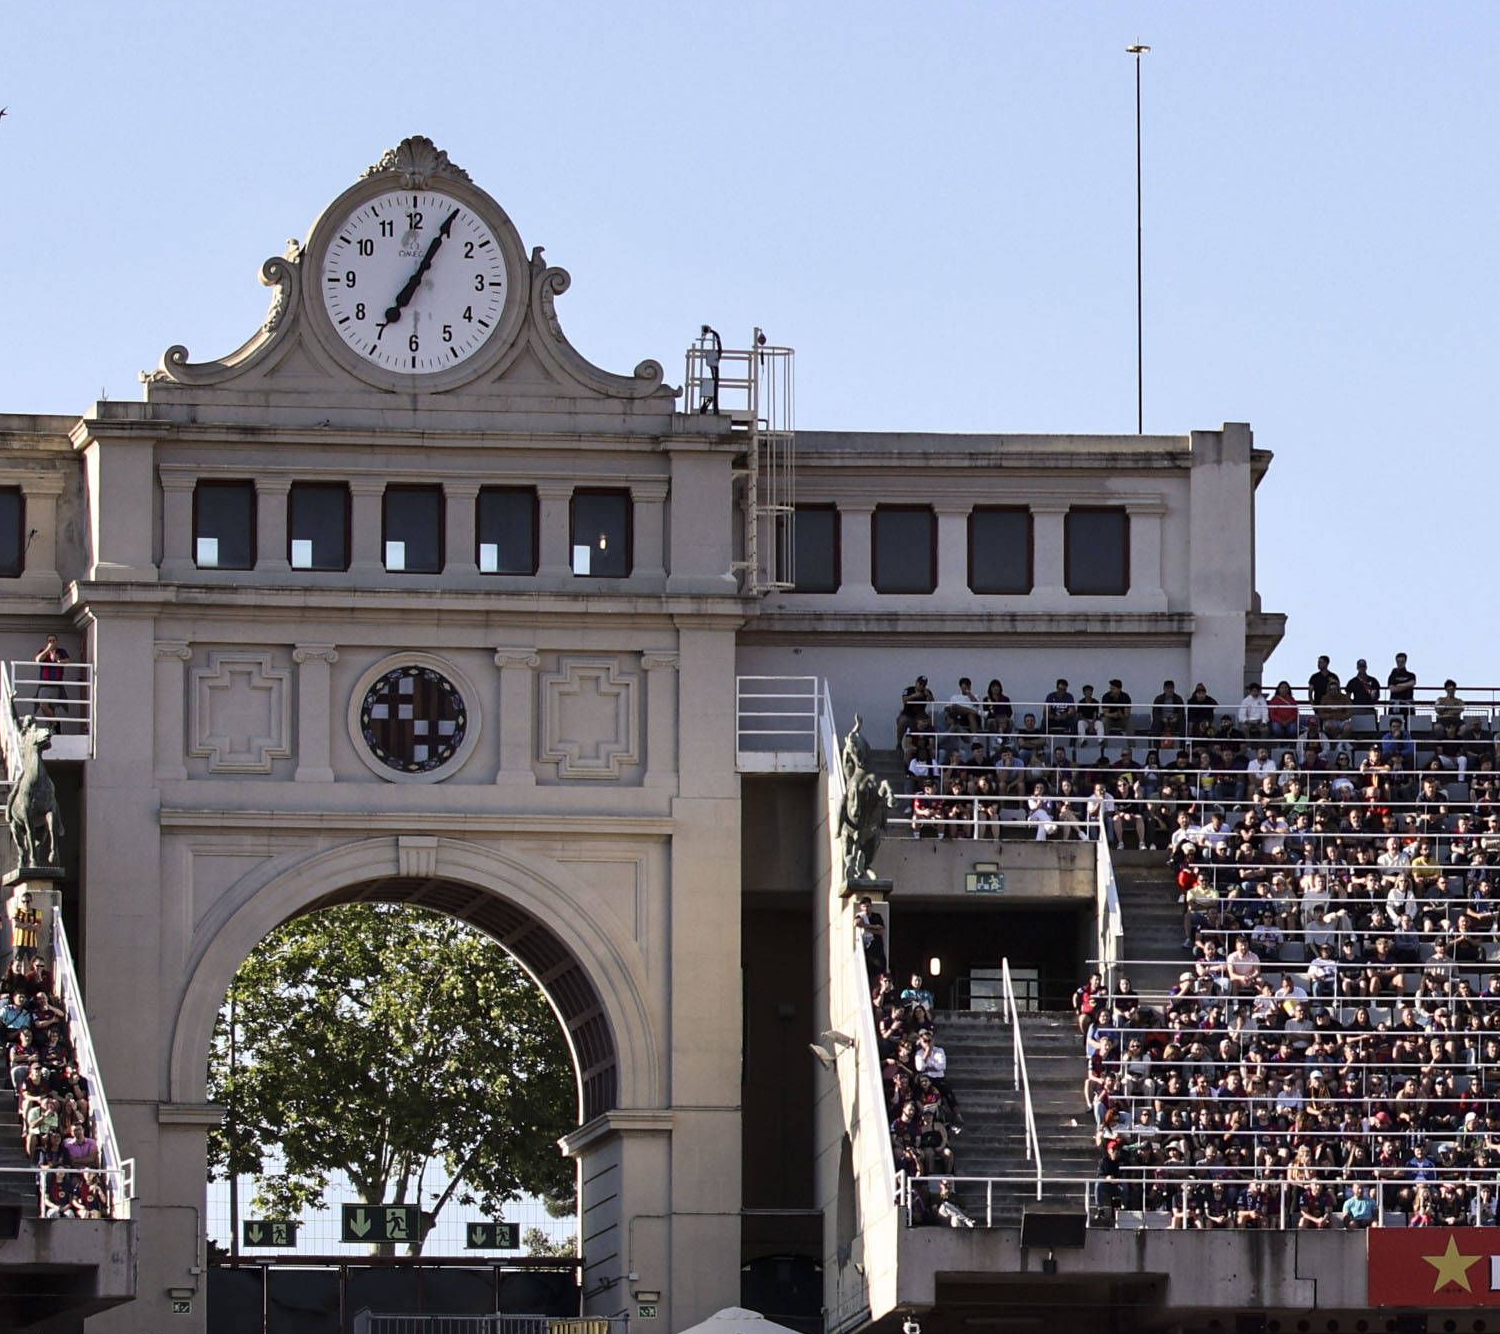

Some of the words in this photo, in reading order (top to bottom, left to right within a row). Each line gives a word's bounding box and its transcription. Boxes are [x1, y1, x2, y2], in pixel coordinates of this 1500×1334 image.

[379, 219, 394, 237] 11
[406, 212, 423, 230] 12
[357, 239, 374, 256] 10
[464, 242, 474, 259] 2
[346, 271, 356, 288] 9
[474, 274, 485, 292] 3
[355, 303, 366, 320] 8
[463, 306, 473, 323] 4
[375, 323, 387, 340] 7
[442, 325, 452, 342] 5
[409, 335, 419, 352] 6
